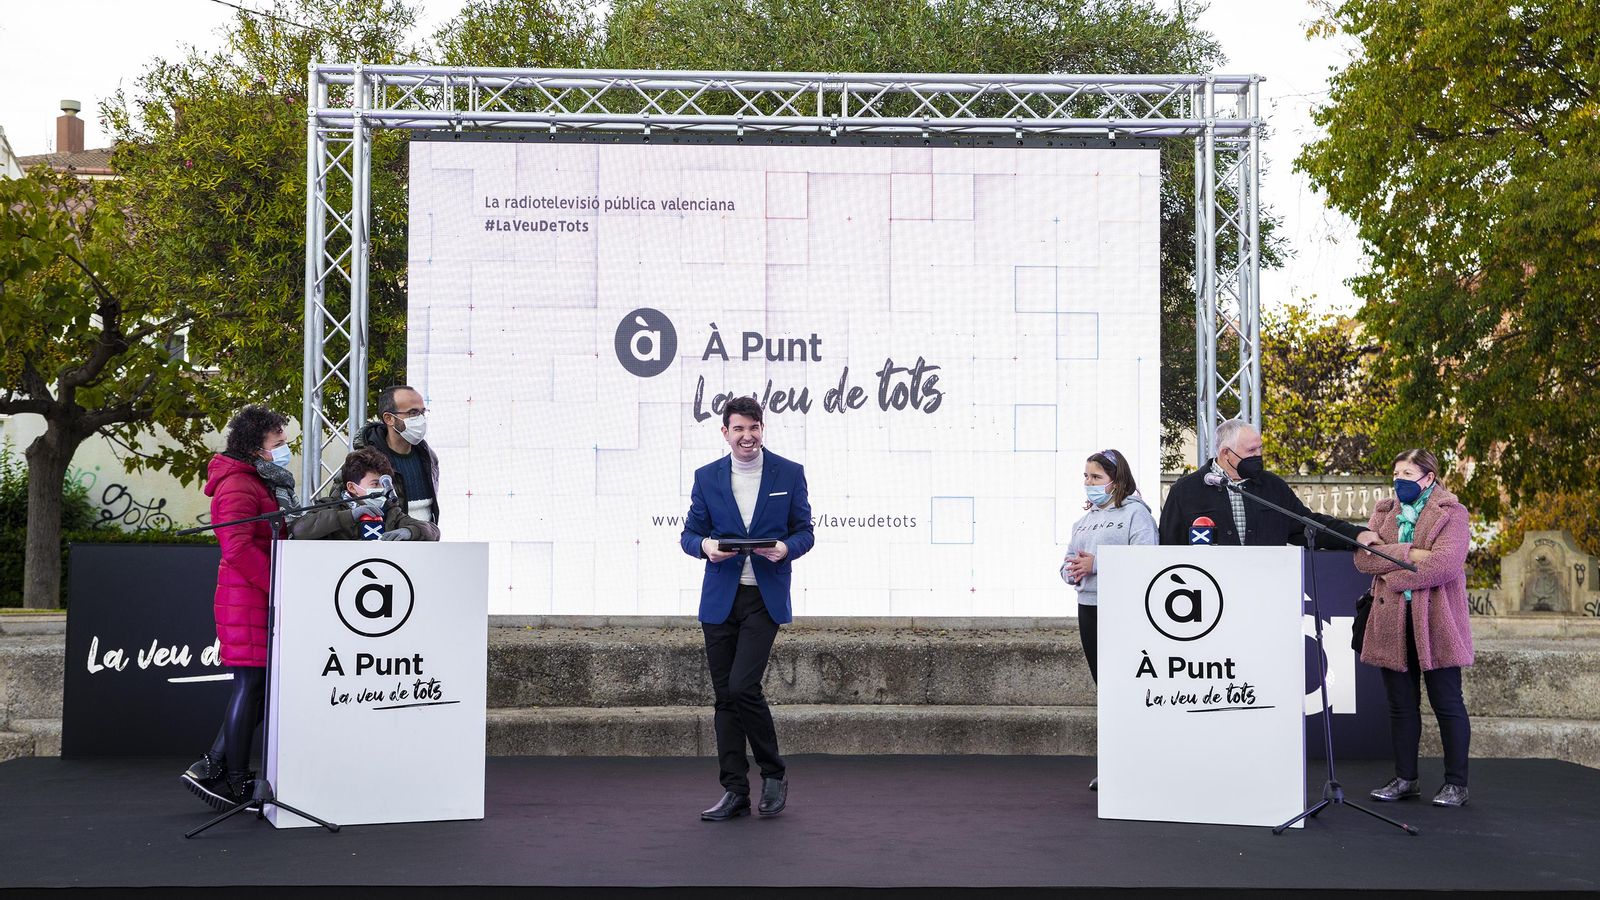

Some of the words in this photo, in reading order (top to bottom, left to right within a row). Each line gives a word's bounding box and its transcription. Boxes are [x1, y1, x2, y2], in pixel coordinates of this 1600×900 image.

[485, 196, 500, 209] La
[504, 195, 600, 210] radiotelevisió
[604, 195, 656, 213] pública
[660, 197, 736, 211] valenciana
[485, 219, 589, 233] #LaVeuDeTots
[702, 322, 730, 361] À
[742, 331, 822, 362] Punt
[824, 366, 868, 414] de
[876, 355, 946, 414] tots
[87, 636, 130, 674] La
[137, 638, 193, 670] veu
[200, 637, 222, 667] d
[321, 646, 346, 677] À
[355, 653, 424, 676] Punt
[1135, 649, 1159, 679] À
[1168, 656, 1236, 680] Punt
[330, 687, 353, 706] La
[356, 688, 385, 704] veu
[389, 682, 410, 702] de
[413, 677, 443, 701] tots
[1145, 688, 1167, 708] La
[1170, 690, 1198, 706] veu
[1202, 686, 1223, 705] de
[1225, 682, 1256, 705] tots
